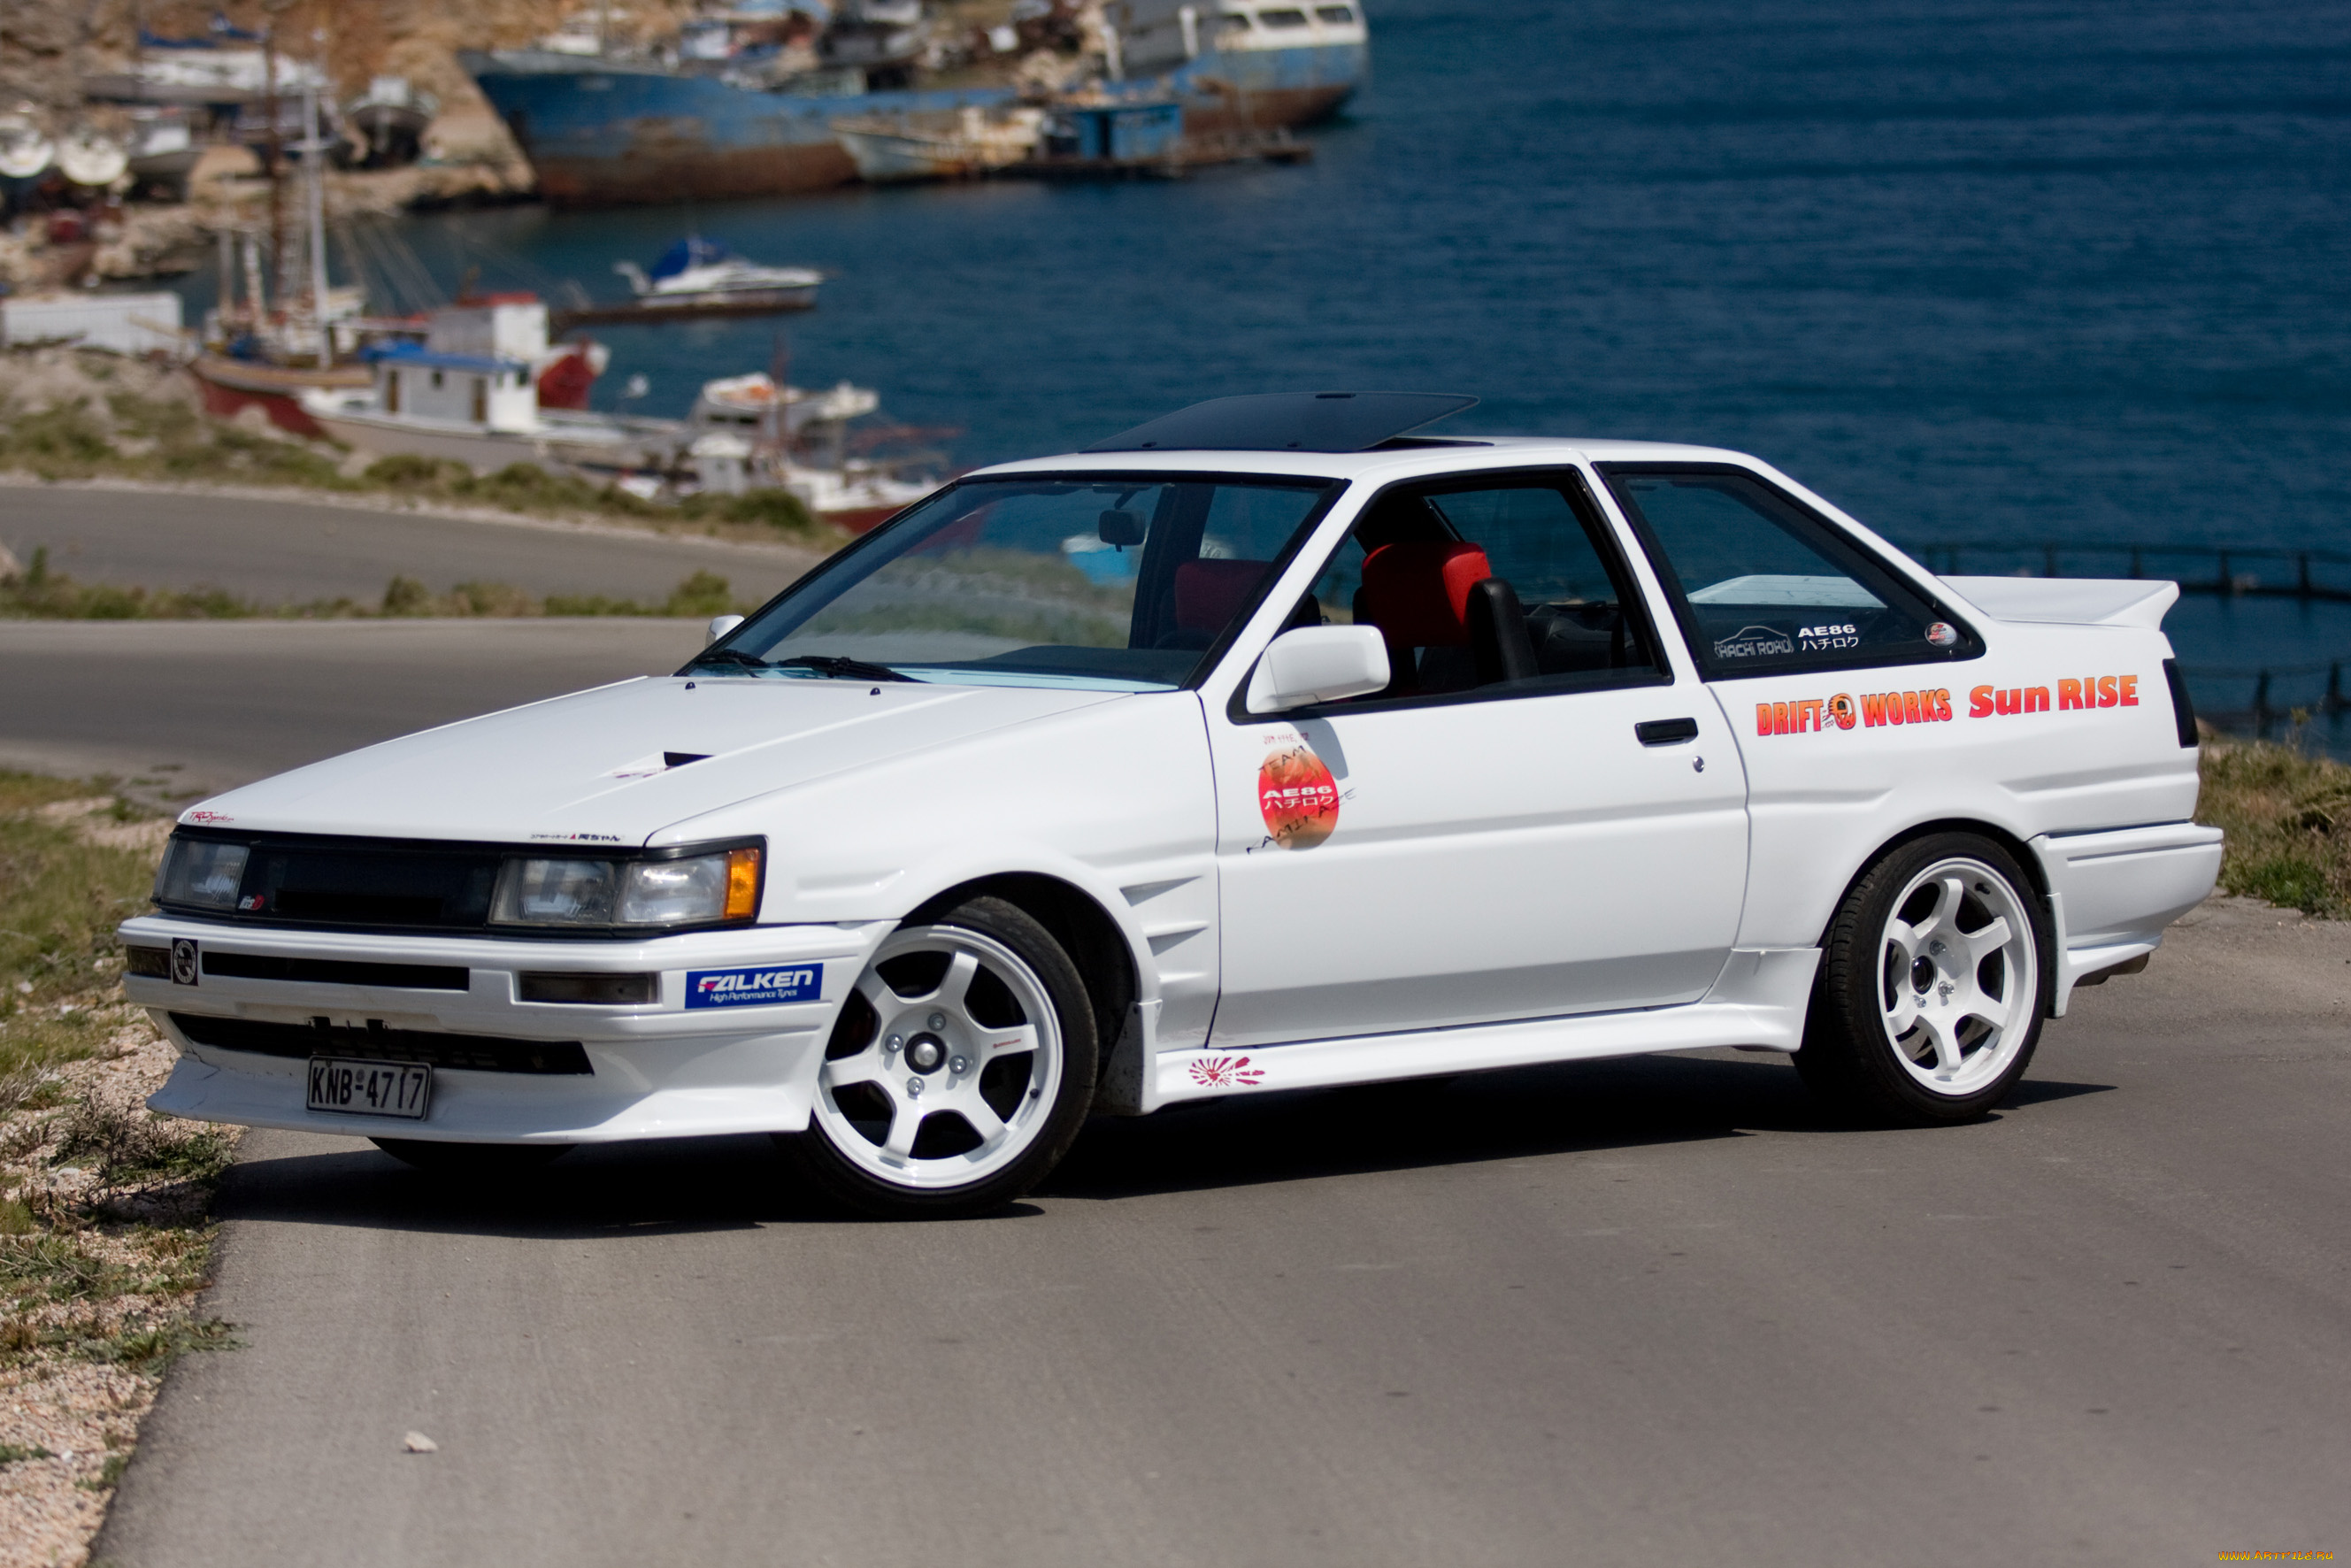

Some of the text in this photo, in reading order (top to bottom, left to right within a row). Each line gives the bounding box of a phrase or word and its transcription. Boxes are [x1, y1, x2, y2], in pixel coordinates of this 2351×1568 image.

[1798, 625, 1856, 637] AE86
[1802, 636, 1859, 651] ハチロク
[1756, 675, 2139, 736] DRIFT WORKS Sun RISE
[1263, 786, 1333, 799] AE86
[1264, 796, 1333, 810] ハチロク
[697, 970, 813, 993] FALKEN
[710, 993, 728, 1003] High
[728, 990, 777, 1001] Performance
[311, 1067, 424, 1110] KNB-4717
